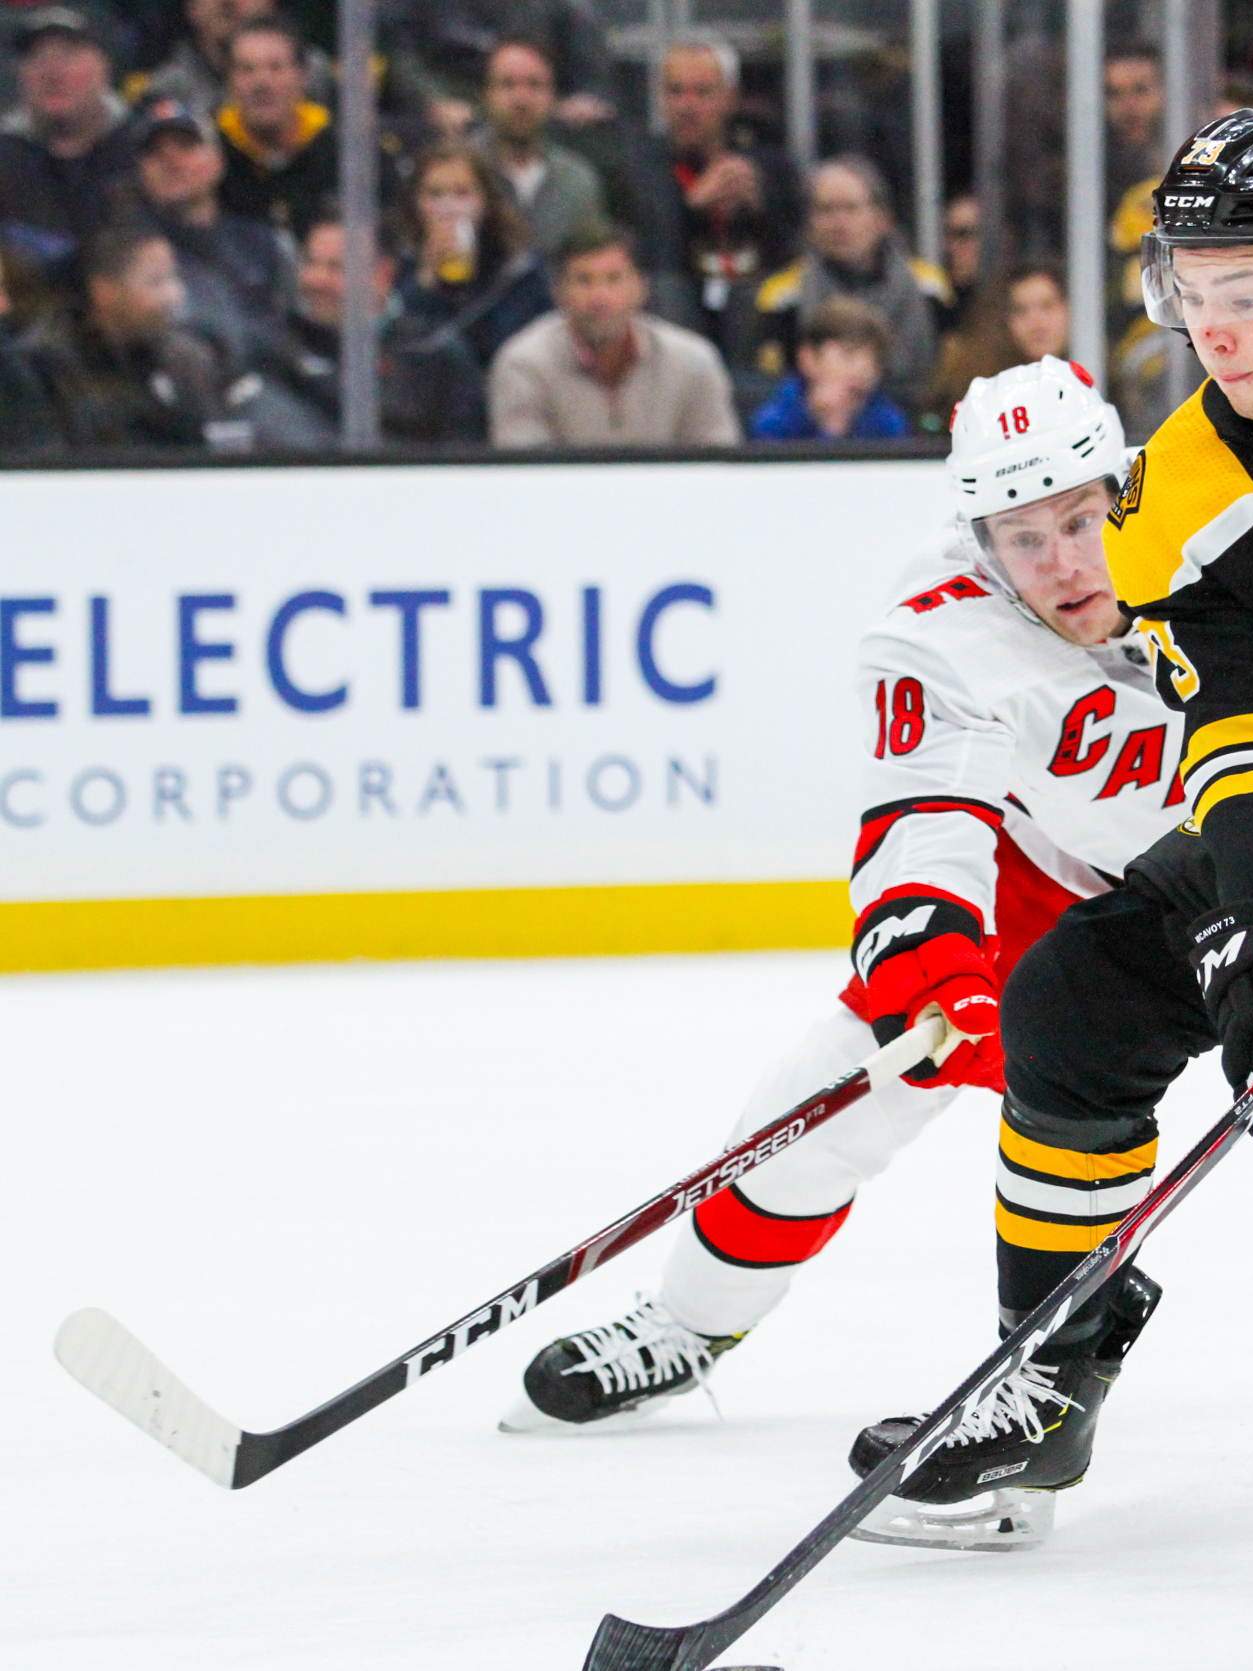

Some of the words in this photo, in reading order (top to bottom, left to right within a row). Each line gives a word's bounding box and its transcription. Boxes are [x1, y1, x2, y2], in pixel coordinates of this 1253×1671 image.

[1181, 140, 1226, 165] 73
[1164, 196, 1215, 208] CCM
[998, 406, 1030, 440] 18
[0, 582, 718, 719] ELECTRIC
[875, 676, 925, 760] 18
[0, 753, 719, 828] CORPORATION
[1194, 920, 1222, 944] MCAVOY
[1223, 916, 1236, 927] 73
[664, 1117, 806, 1224] JETSPEED
[805, 1103, 826, 1122] FT2
[401, 1278, 539, 1391] CCM
[900, 1296, 1073, 1485] CCM
[982, 1463, 1024, 1482] BAUER
